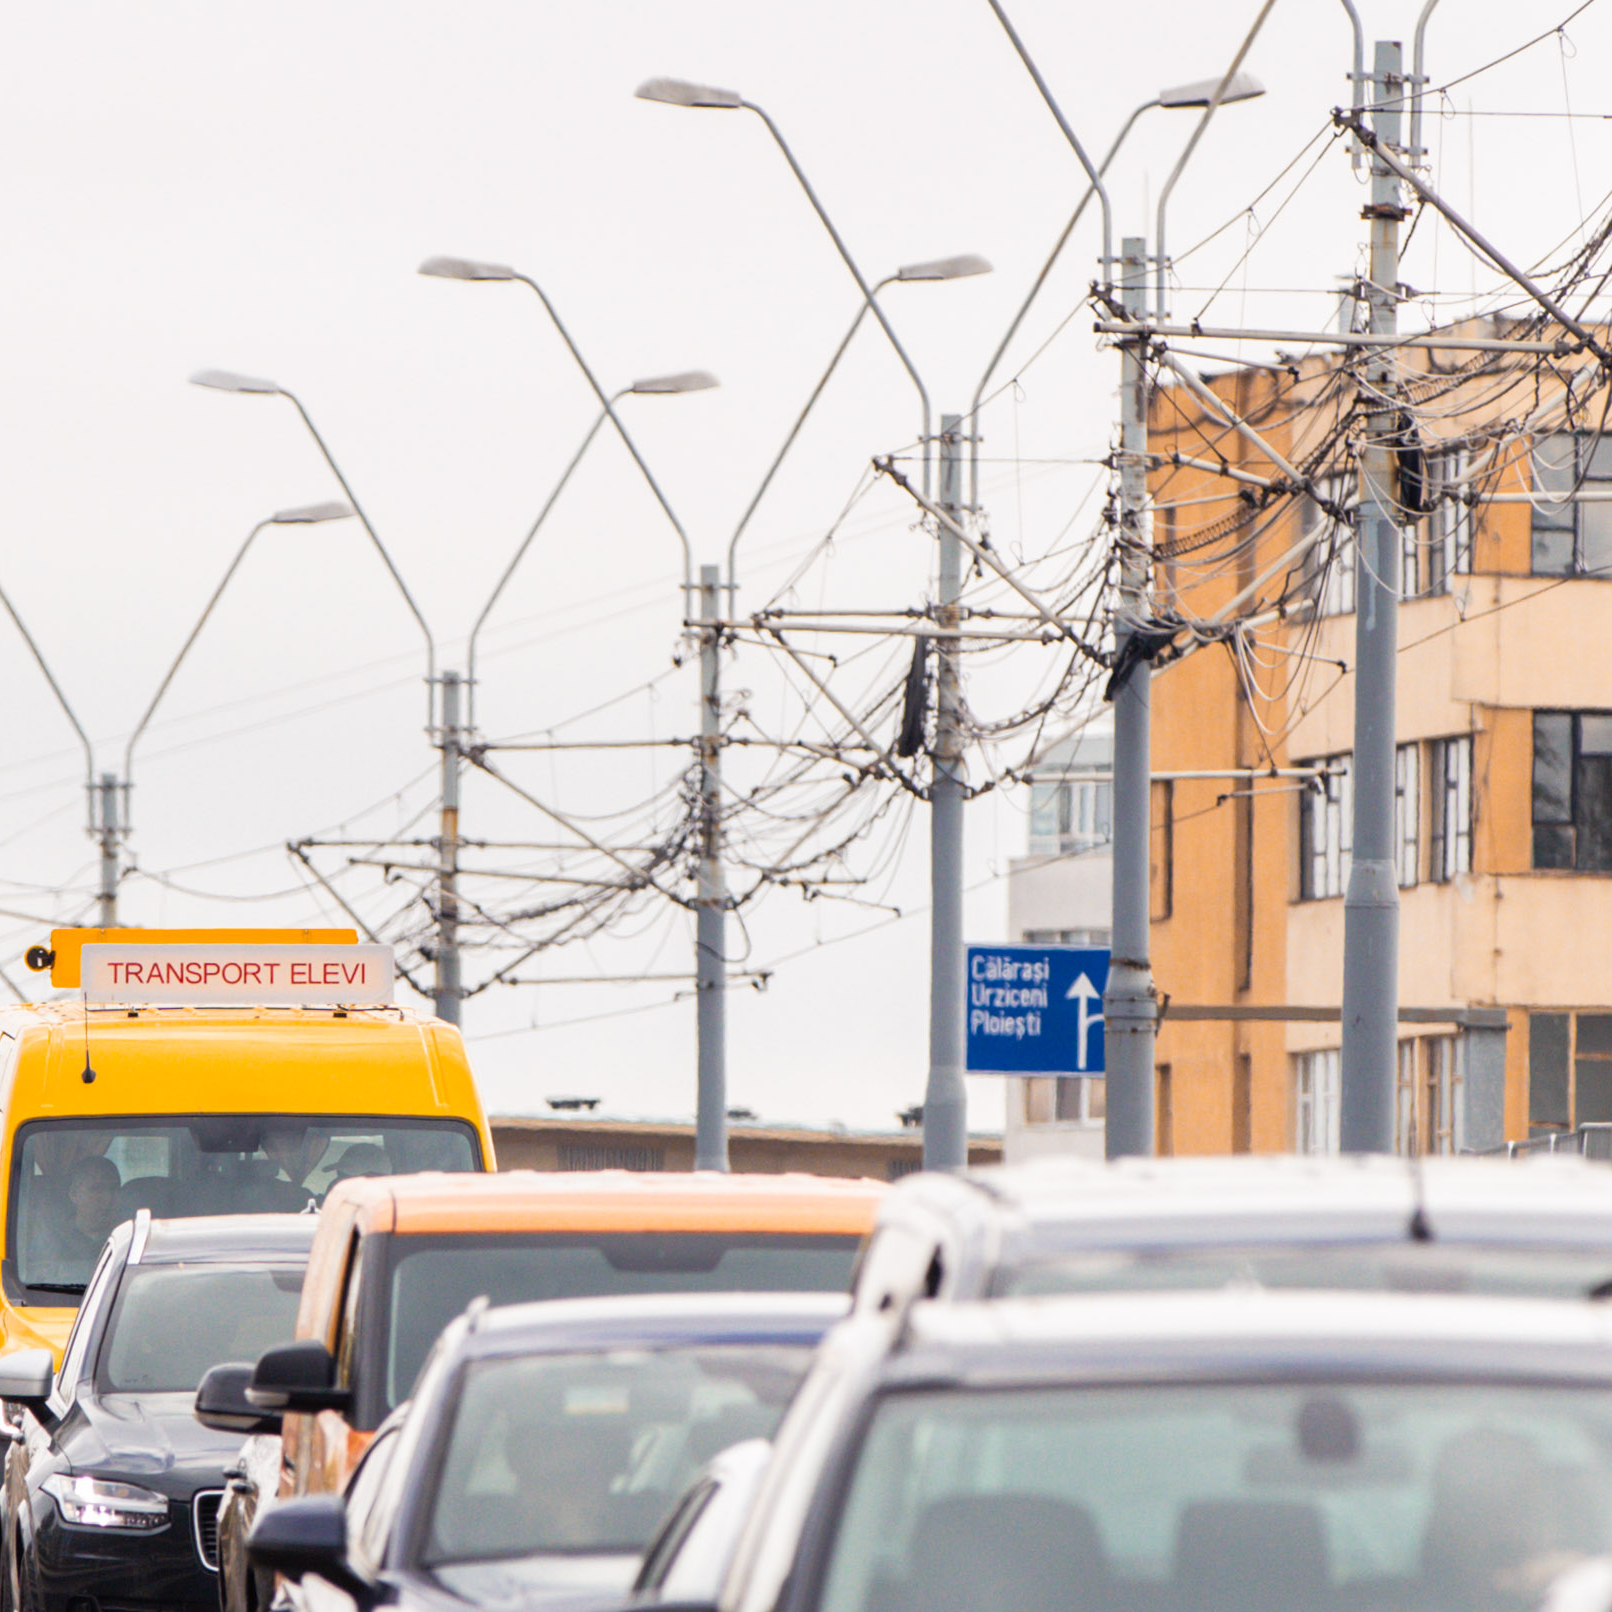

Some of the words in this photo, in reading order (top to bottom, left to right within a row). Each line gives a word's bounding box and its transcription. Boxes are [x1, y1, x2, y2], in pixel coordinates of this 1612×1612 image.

[107, 962, 280, 984] TRANSPORT
[290, 962, 366, 984] ELEVI
[971, 954, 1050, 984] Călărași
[971, 983, 1048, 1008] Urziceni
[970, 1008, 1042, 1040] Ploiești
